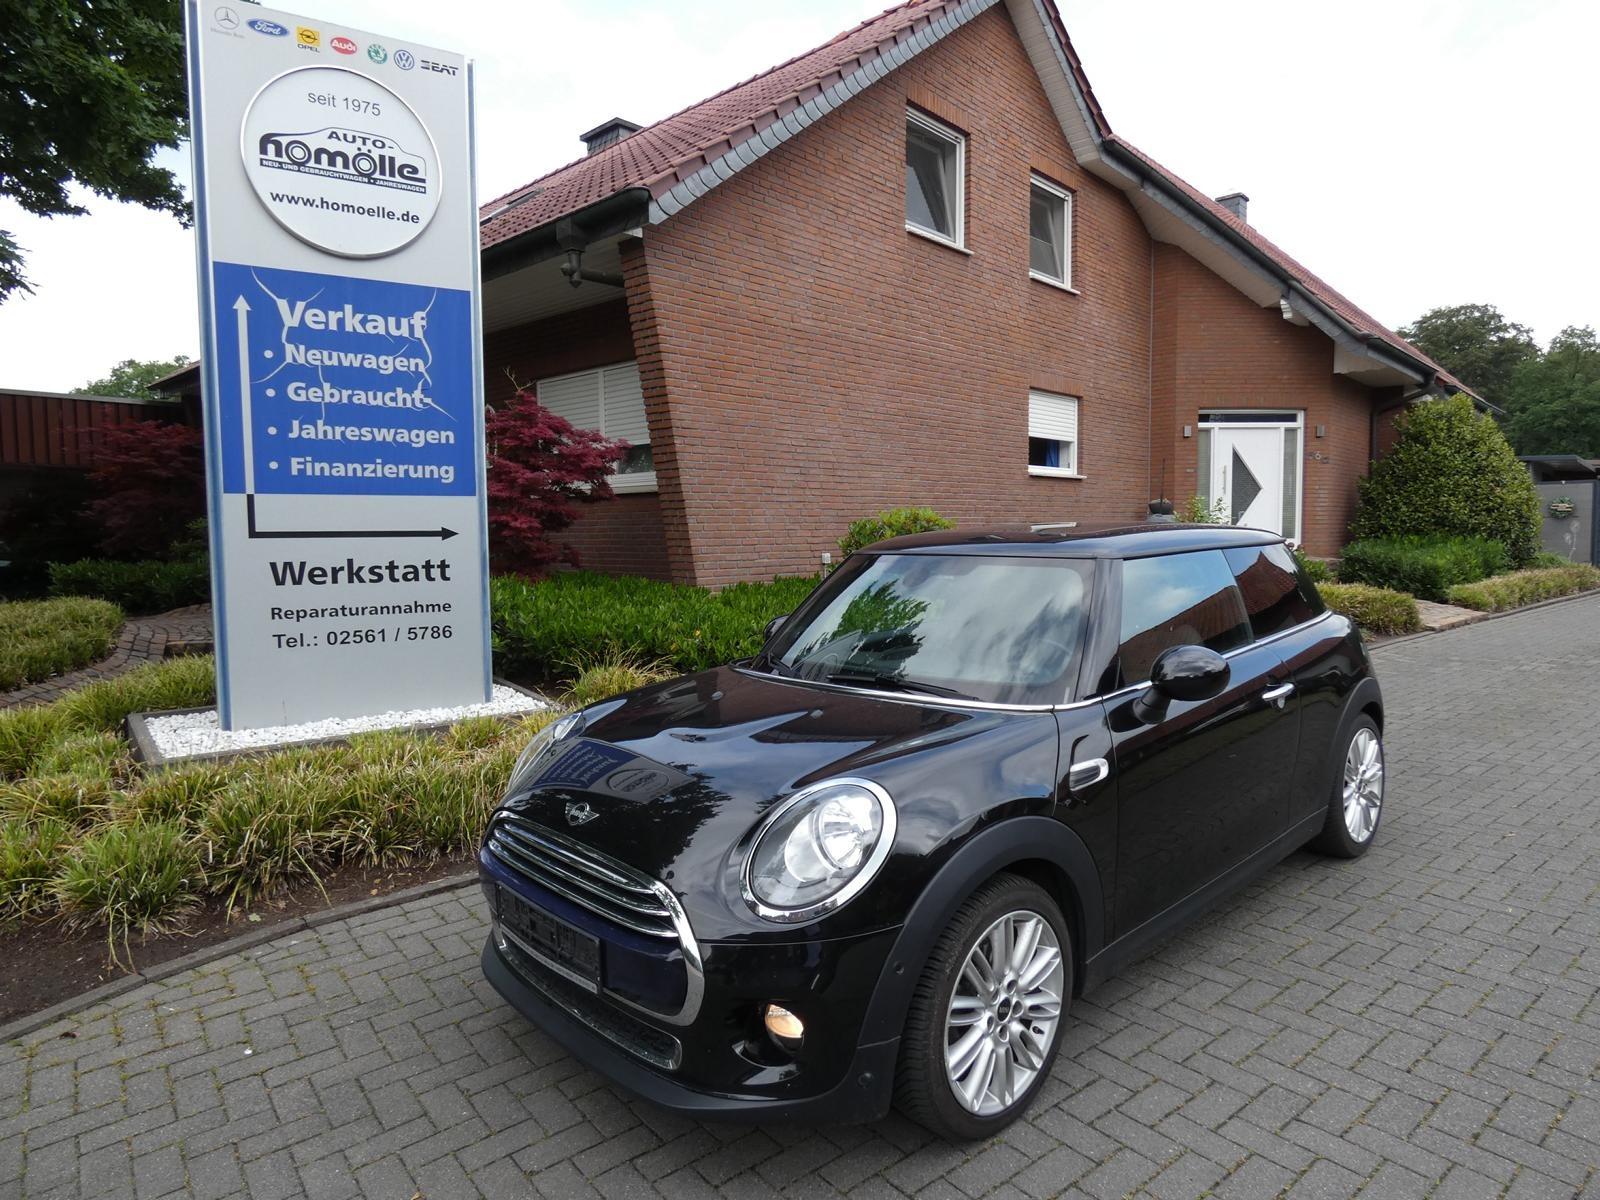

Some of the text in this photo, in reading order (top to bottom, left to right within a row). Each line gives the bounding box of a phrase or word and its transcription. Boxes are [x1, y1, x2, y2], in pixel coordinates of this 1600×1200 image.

[254, 20, 281, 35] Ford
[297, 43, 320, 53] OPEL
[331, 39, 356, 52] Audi
[420, 60, 458, 76] SEAT
[307, 92, 381, 117] seit 1975
[327, 130, 394, 150] AUTO-
[262, 159, 425, 193] NEU- UND GEBRAUCHTWAGEN JAHRESWAGEN
[270, 191, 420, 224] www.homoelle.de
[276, 298, 427, 338] Verkauf
[285, 344, 425, 375] Neuwagen
[288, 419, 455, 447] Jahreswagen
[290, 456, 455, 483] Finanzierung
[269, 558, 451, 586] Werkstatt
[271, 600, 452, 622] Reparaturannahme
[273, 632, 318, 648] Tel.:
[326, 628, 386, 646] 02561
[407, 625, 453, 641] 5786
